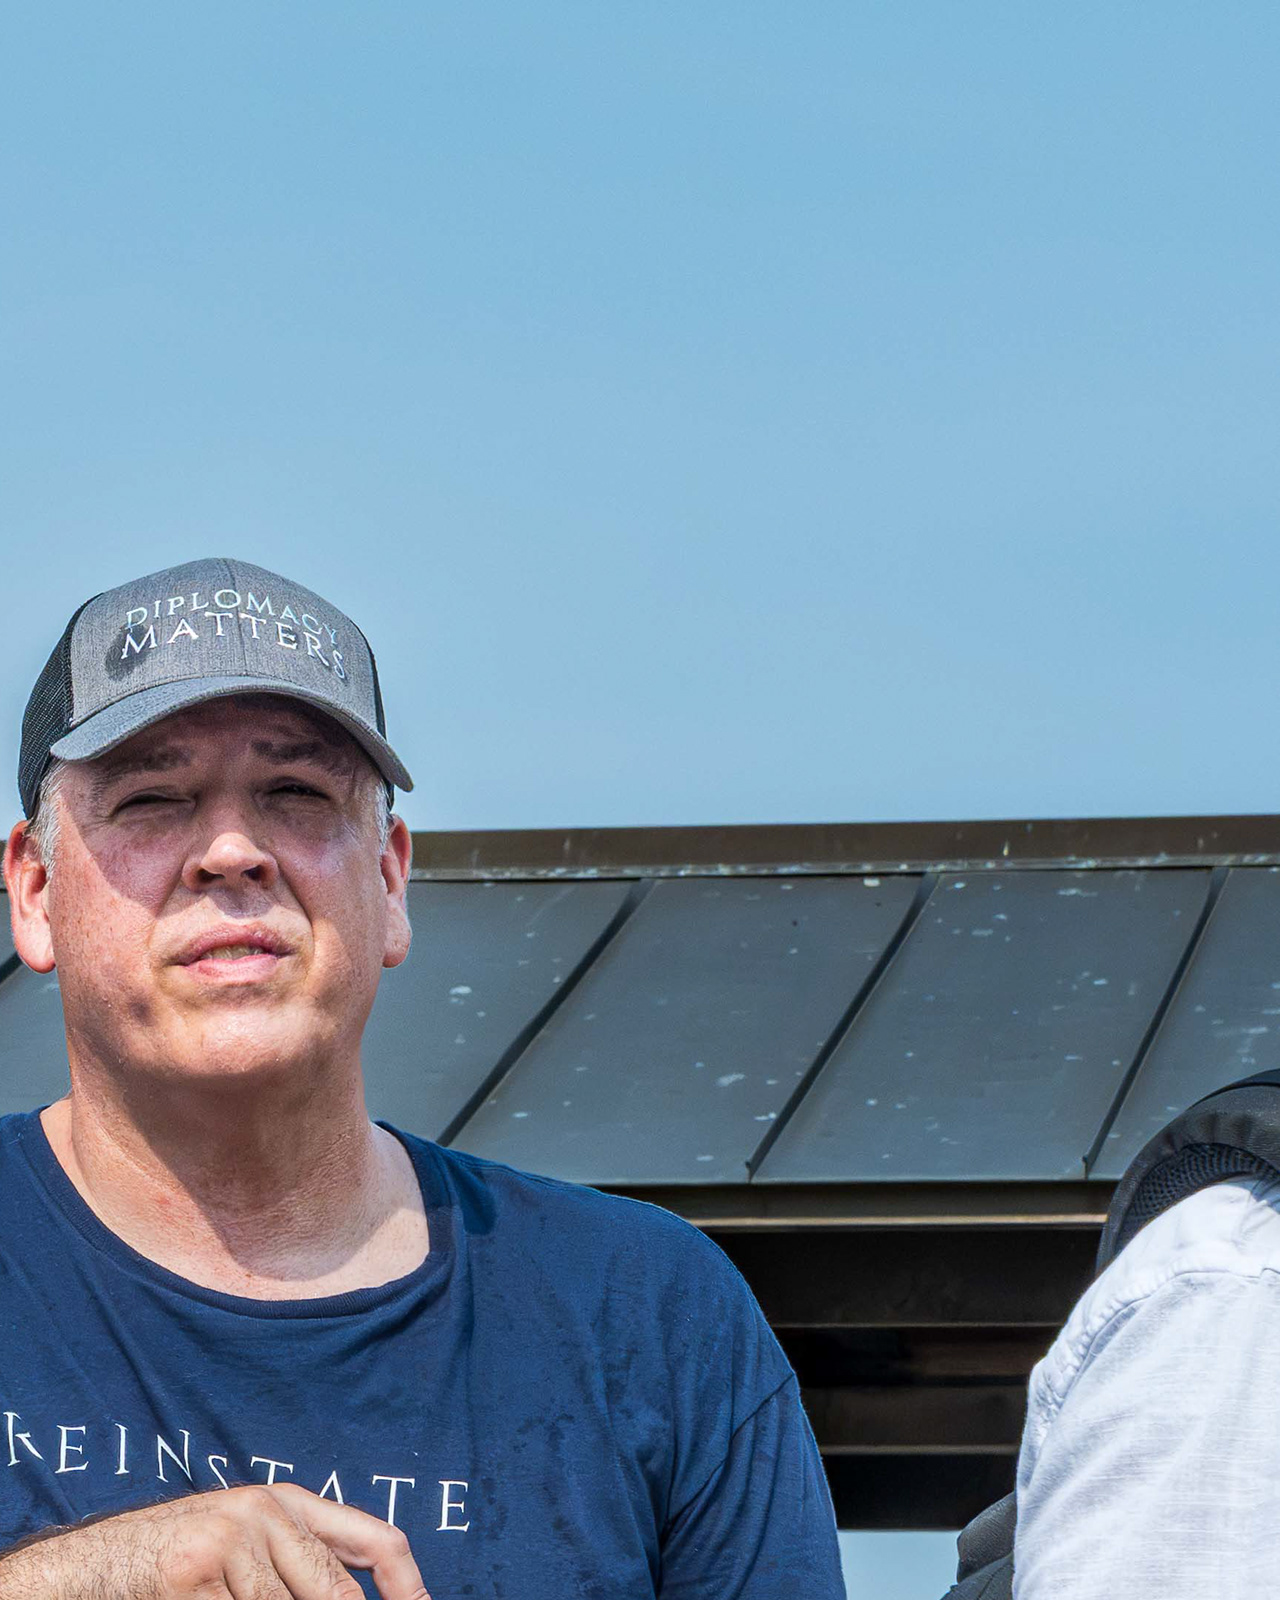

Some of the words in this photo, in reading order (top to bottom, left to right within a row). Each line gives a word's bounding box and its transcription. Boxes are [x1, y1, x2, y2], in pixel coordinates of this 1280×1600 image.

[120, 611, 346, 680] MATTERS
[125, 589, 339, 646] DIPLOMACY
[4, 1412, 470, 1532] REINSTATE
